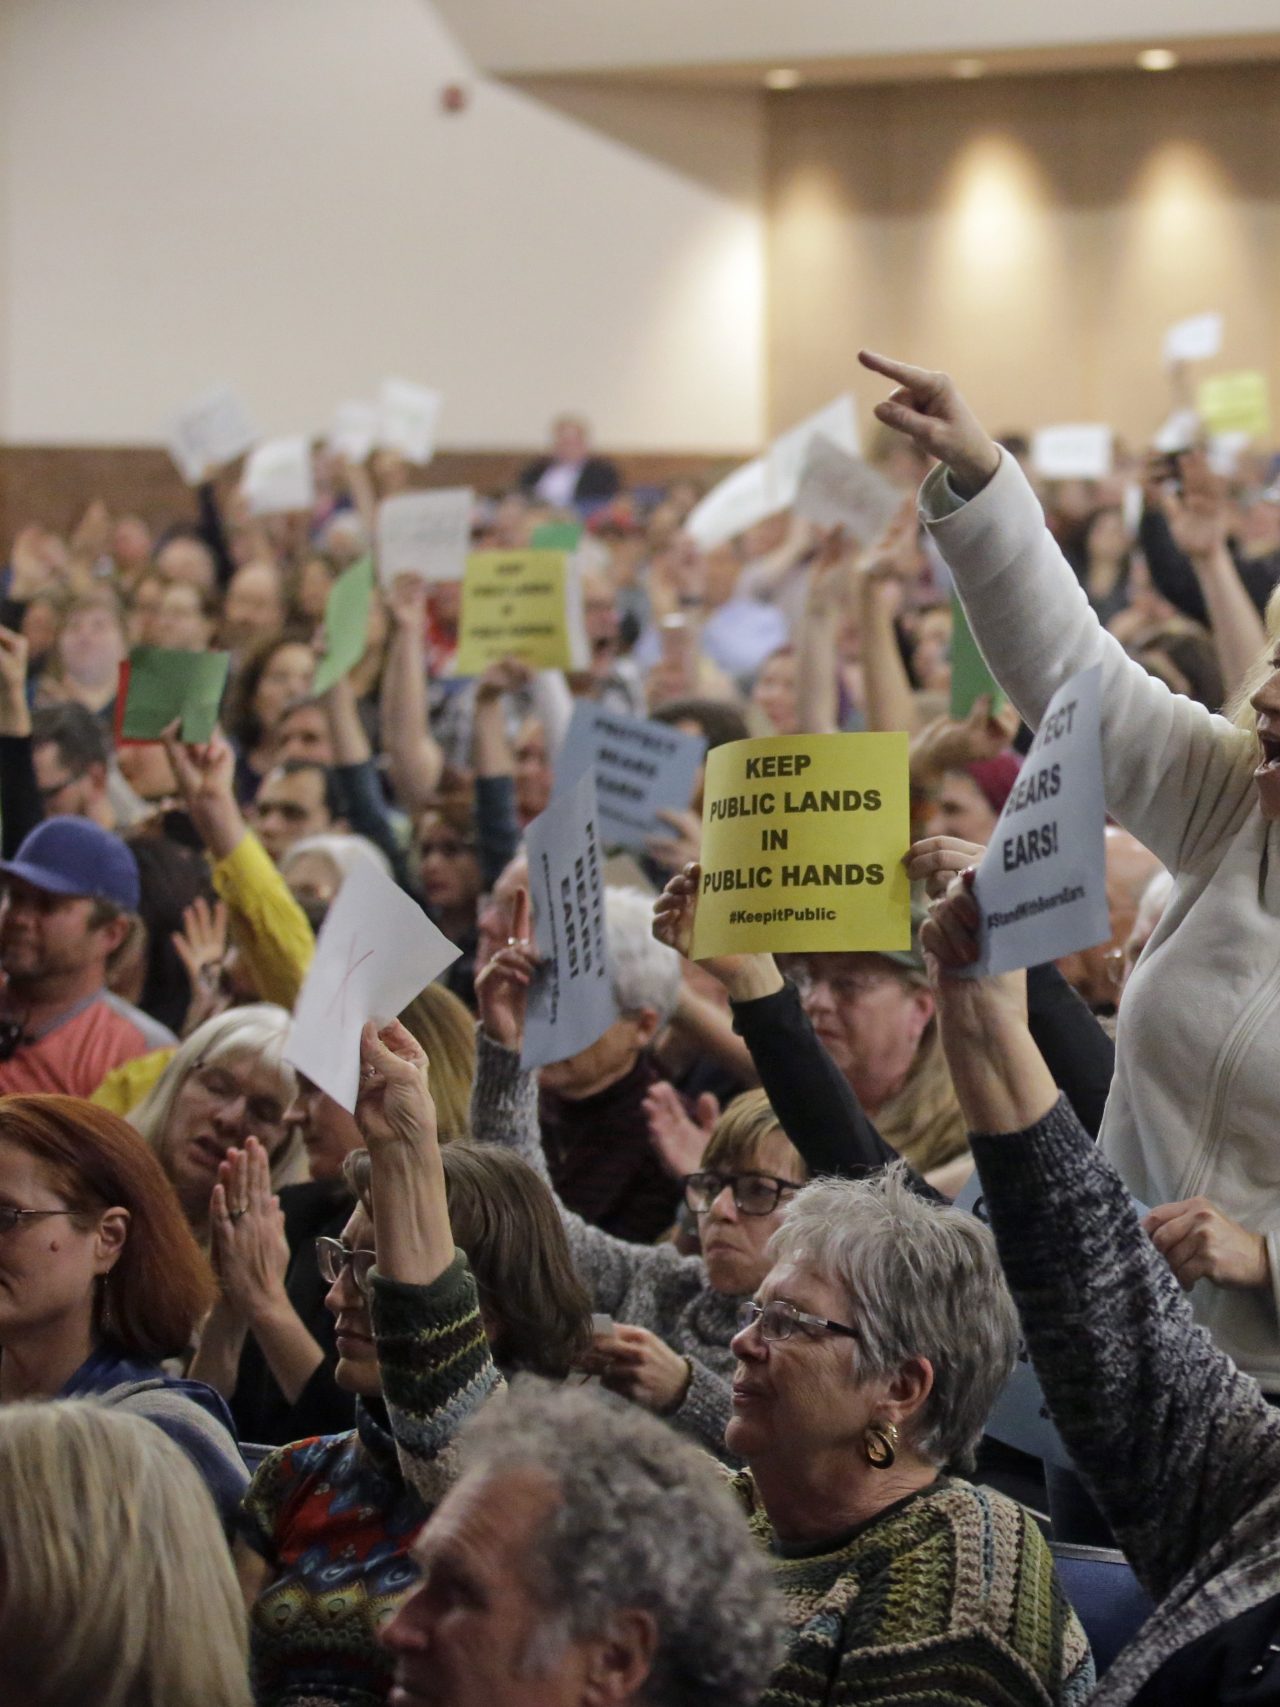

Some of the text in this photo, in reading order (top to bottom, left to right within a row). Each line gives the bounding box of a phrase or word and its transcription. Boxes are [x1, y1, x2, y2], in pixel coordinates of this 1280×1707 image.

[745, 755, 811, 779] KEEP
[710, 790, 882, 822] PUBLIC LANDS
[761, 829, 788, 851] IN
[1003, 821, 1058, 872] EARS!
[703, 864, 885, 895] PUBLIC HANDS
[729, 907, 837, 925] #KeepitPublic
